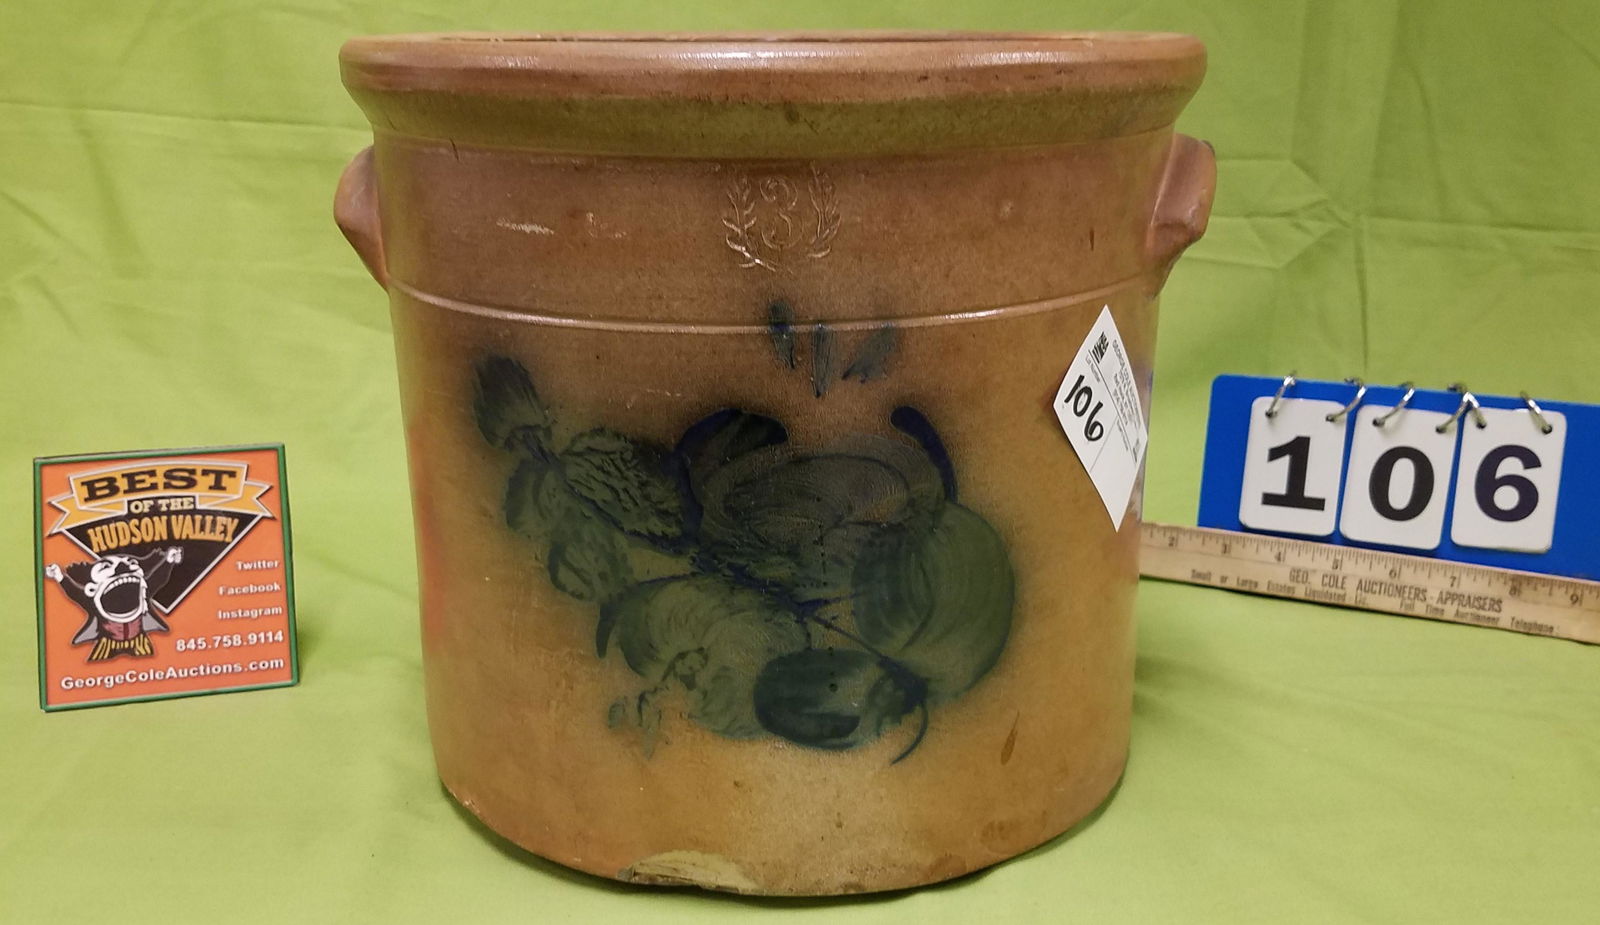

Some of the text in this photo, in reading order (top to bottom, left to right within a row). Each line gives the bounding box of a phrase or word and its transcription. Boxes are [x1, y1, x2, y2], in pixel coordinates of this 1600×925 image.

[760, 177, 803, 249] 3
[1063, 374, 1104, 442] 106
[81, 468, 236, 502] BEST
[130, 497, 194, 514] OF THE
[87, 514, 240, 554] HUDSON VALLEY
[236, 560, 280, 571] Twitter
[219, 582, 281, 595] Facebook
[1321, 573, 1347, 590] COLE
[1356, 579, 1427, 602] AUCTIONEERS
[1436, 590, 1502, 613] APPRAISERS
[1388, 567, 1397, 579] 6
[1450, 575, 1457, 588] 7
[1570, 593, 1578, 606] 9
[218, 606, 283, 620] Instagram
[176, 630, 284, 651] 845.758.9114
[60, 658, 285, 690] GeorgeColeAuctions.com
